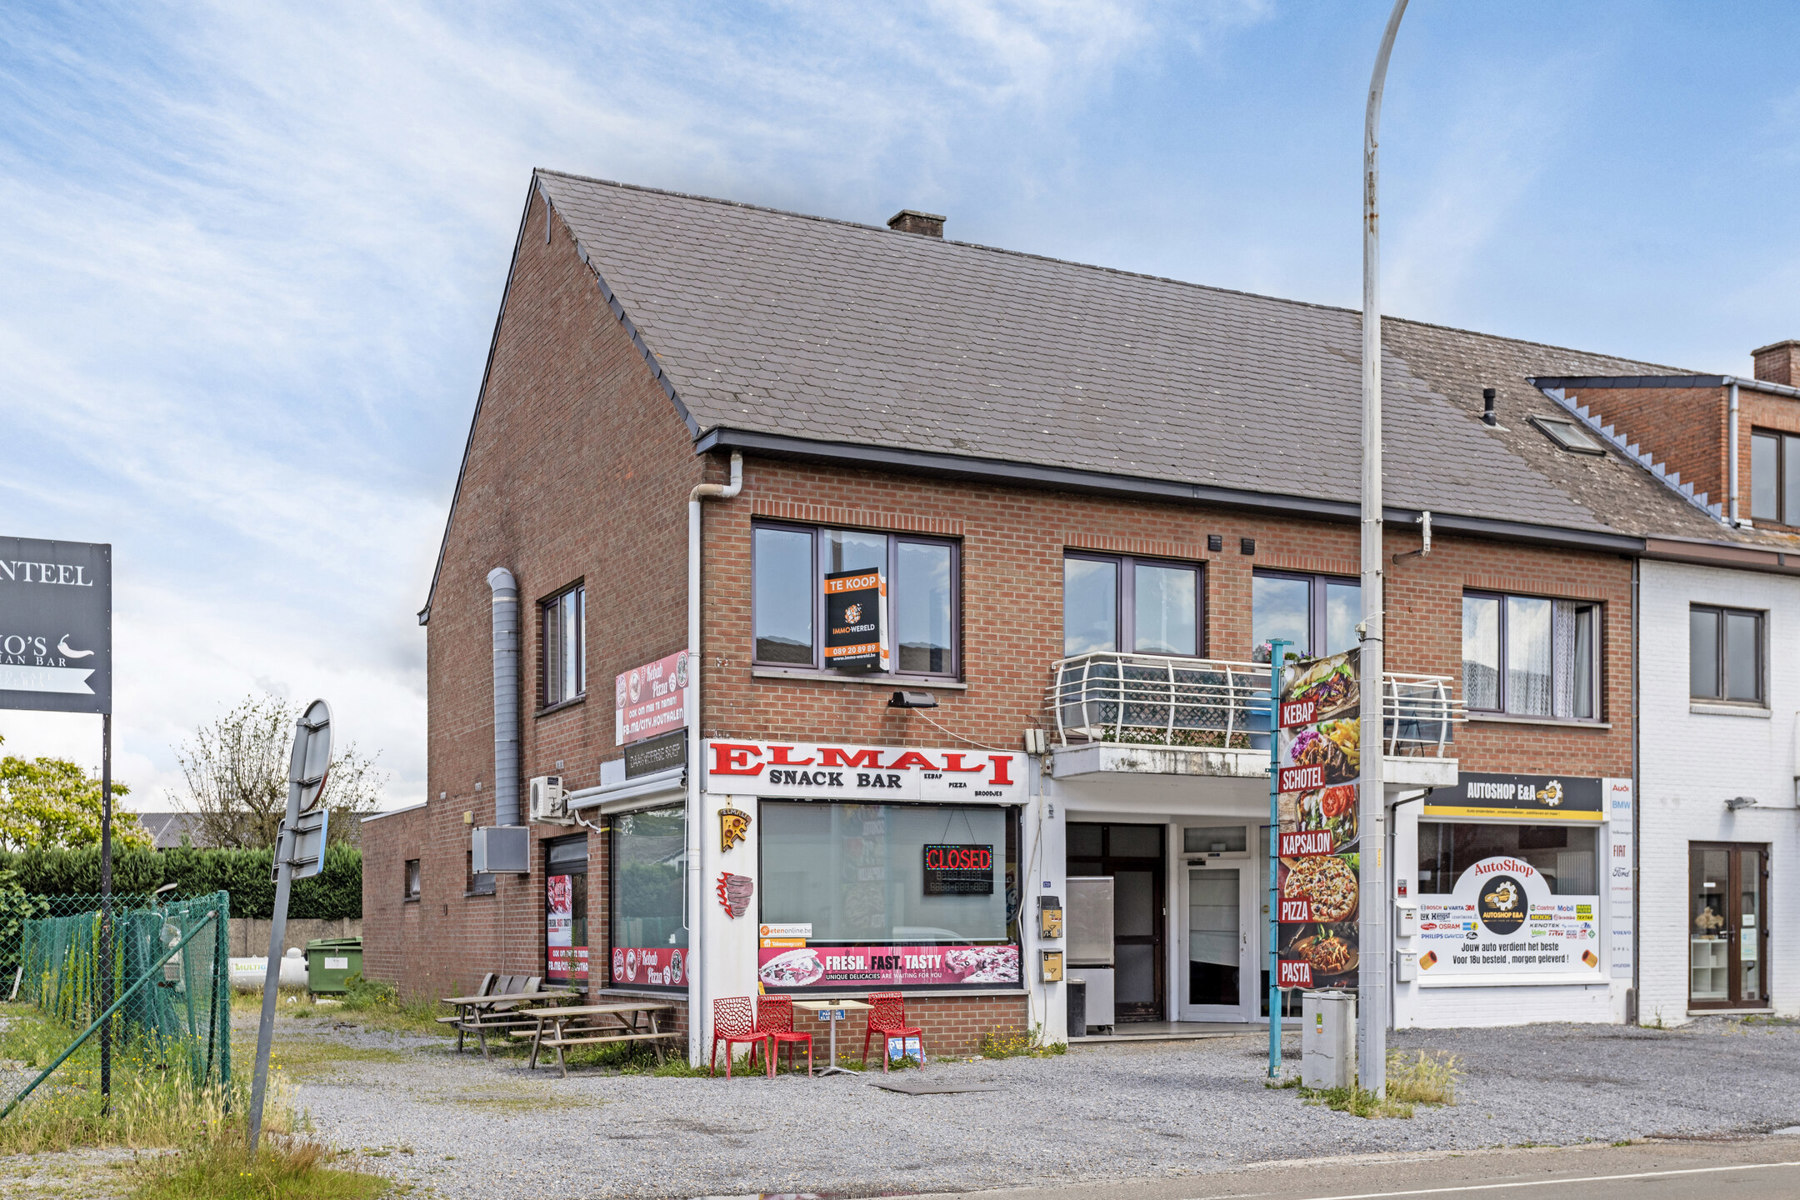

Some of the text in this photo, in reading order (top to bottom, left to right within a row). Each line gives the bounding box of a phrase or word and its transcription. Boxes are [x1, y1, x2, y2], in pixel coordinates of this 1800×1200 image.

[830, 576, 876, 591] TE KOOP
[832, 624, 875, 634] IMMO-WERELD
[0, 634, 47, 657] O'S
[858, 645, 866, 653] 89
[867, 644, 876, 652] 89
[36, 656, 66, 667] BAR
[652, 681, 668, 698] Pizza
[1283, 701, 1314, 725] KEBAP
[710, 743, 1014, 785] ELMALI
[769, 769, 902, 788] SNACK BAR
[1283, 767, 1323, 790] SCHOTEL
[1467, 782, 1536, 801] AUTOSHOP E&A
[1612, 784, 1629, 792] Audi
[1612, 800, 1631, 809] BMW
[1283, 832, 1331, 855] KAPSALON
[1613, 845, 1626, 857] FIAT
[927, 849, 991, 869] CLOSED
[1475, 859, 1534, 877] AutoShop
[1613, 867, 1630, 877] Ford
[1282, 901, 1308, 921] PIZZA
[770, 927, 811, 935] etenonline.be
[1461, 942, 1559, 952] Jouw auto verdient het beste
[642, 950, 658, 966] Kebab
[826, 954, 942, 970] FRESH. FAST. TASTY
[1452, 955, 1468, 964] Voor
[1469, 955, 1481, 964] 18u
[1482, 954, 1507, 964] besteld
[1511, 955, 1537, 964] morgen
[1537, 954, 1566, 964] geleverd
[647, 968, 662, 984] Pizza
[1282, 962, 1310, 982] PASTA
